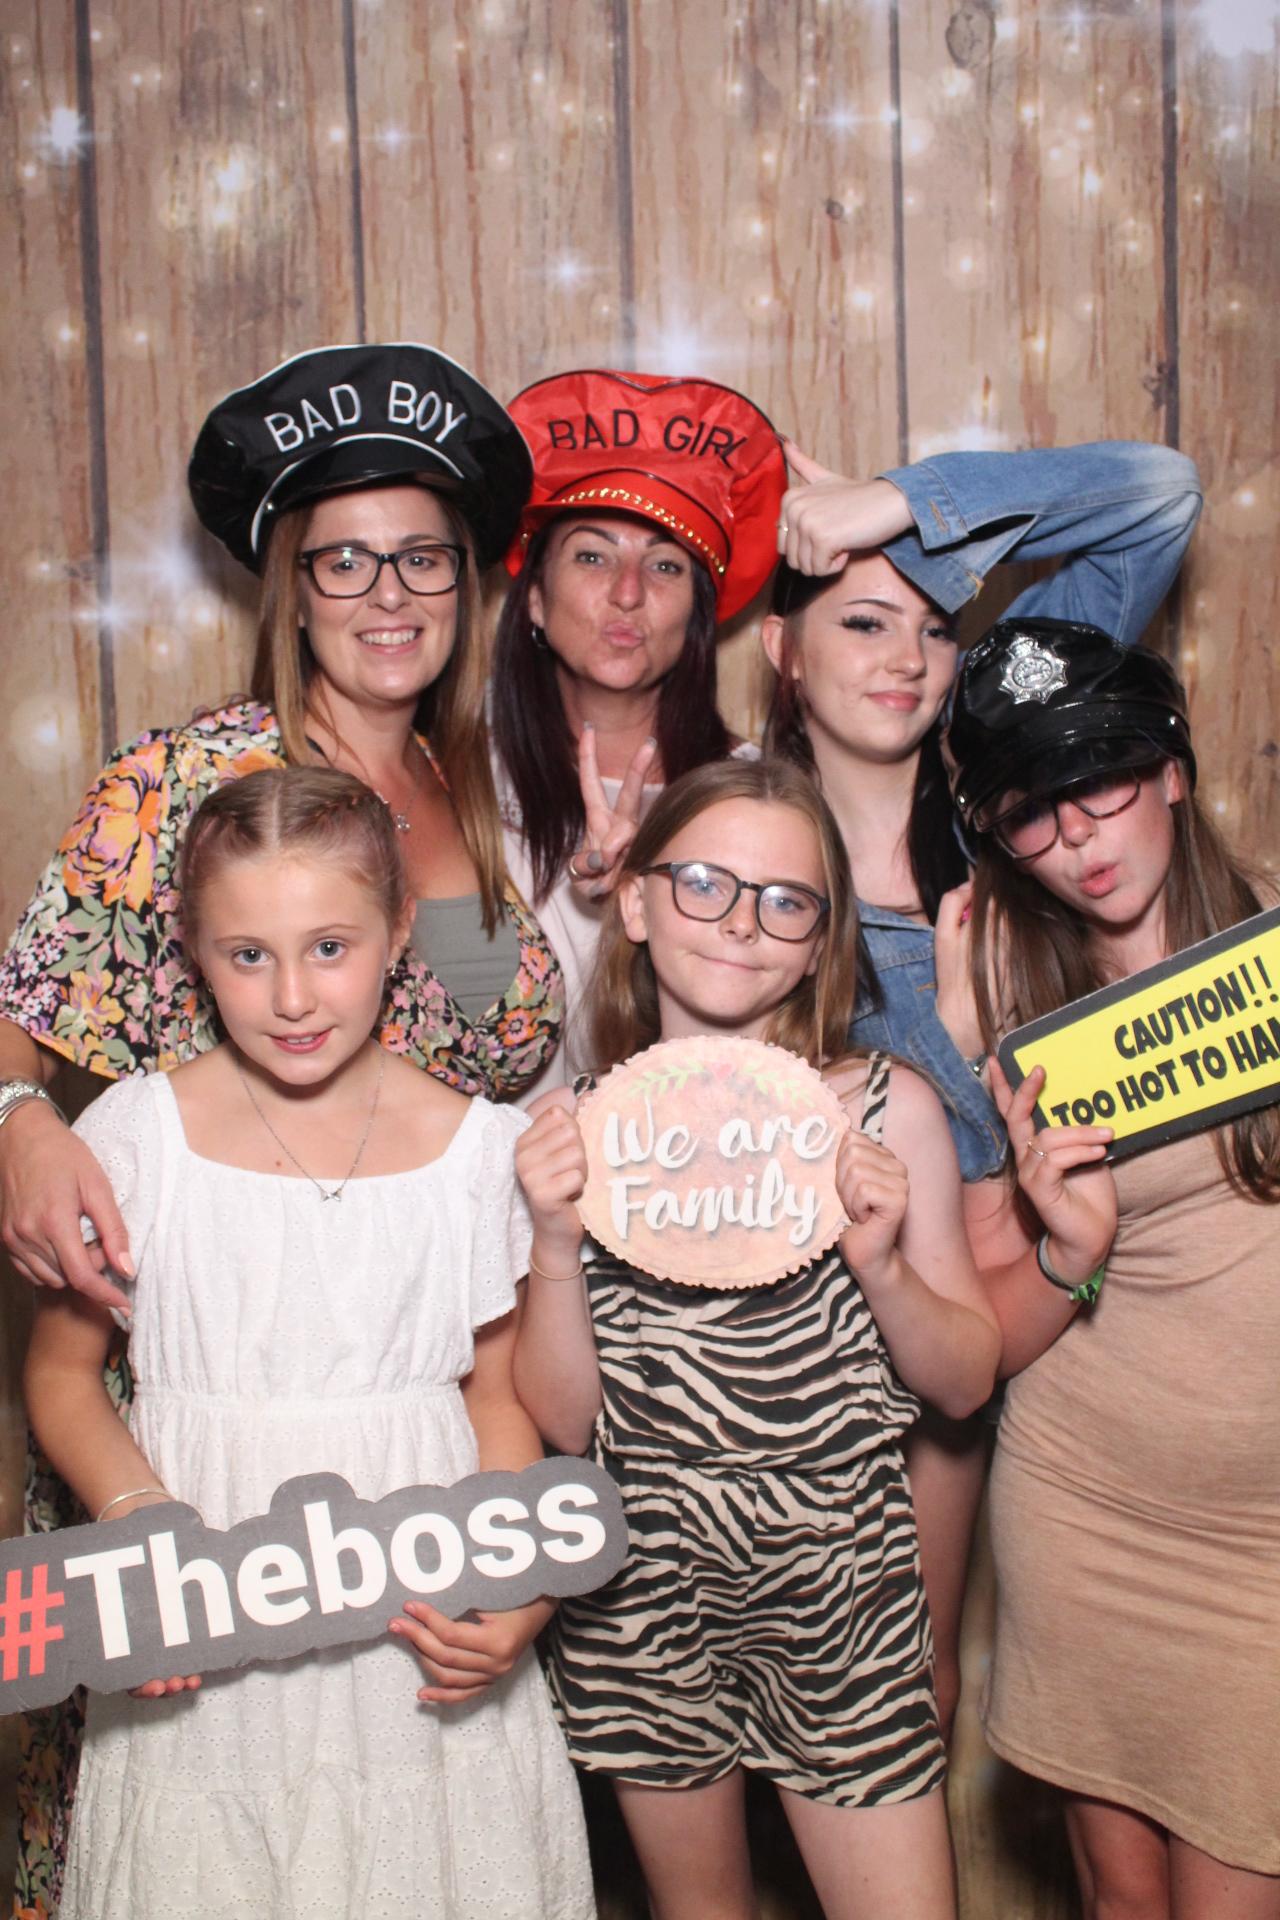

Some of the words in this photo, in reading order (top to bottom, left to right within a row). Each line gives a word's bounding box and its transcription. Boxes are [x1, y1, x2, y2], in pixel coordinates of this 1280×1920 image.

[264, 383, 362, 453] BAD
[387, 380, 468, 445] BOY
[548, 408, 640, 450] BAD
[663, 415, 748, 468] GIRL
[1114, 956, 1279, 1059] CAUTION!!
[1050, 1089, 1116, 1127] TOO
[1116, 1059, 1181, 1113] HOT
[1180, 1045, 1228, 1088] TO
[603, 1096, 698, 1169] We
[718, 1114, 836, 1160] are
[607, 1158, 822, 1246] Family
[0, 1483, 606, 1682] #Theboss
